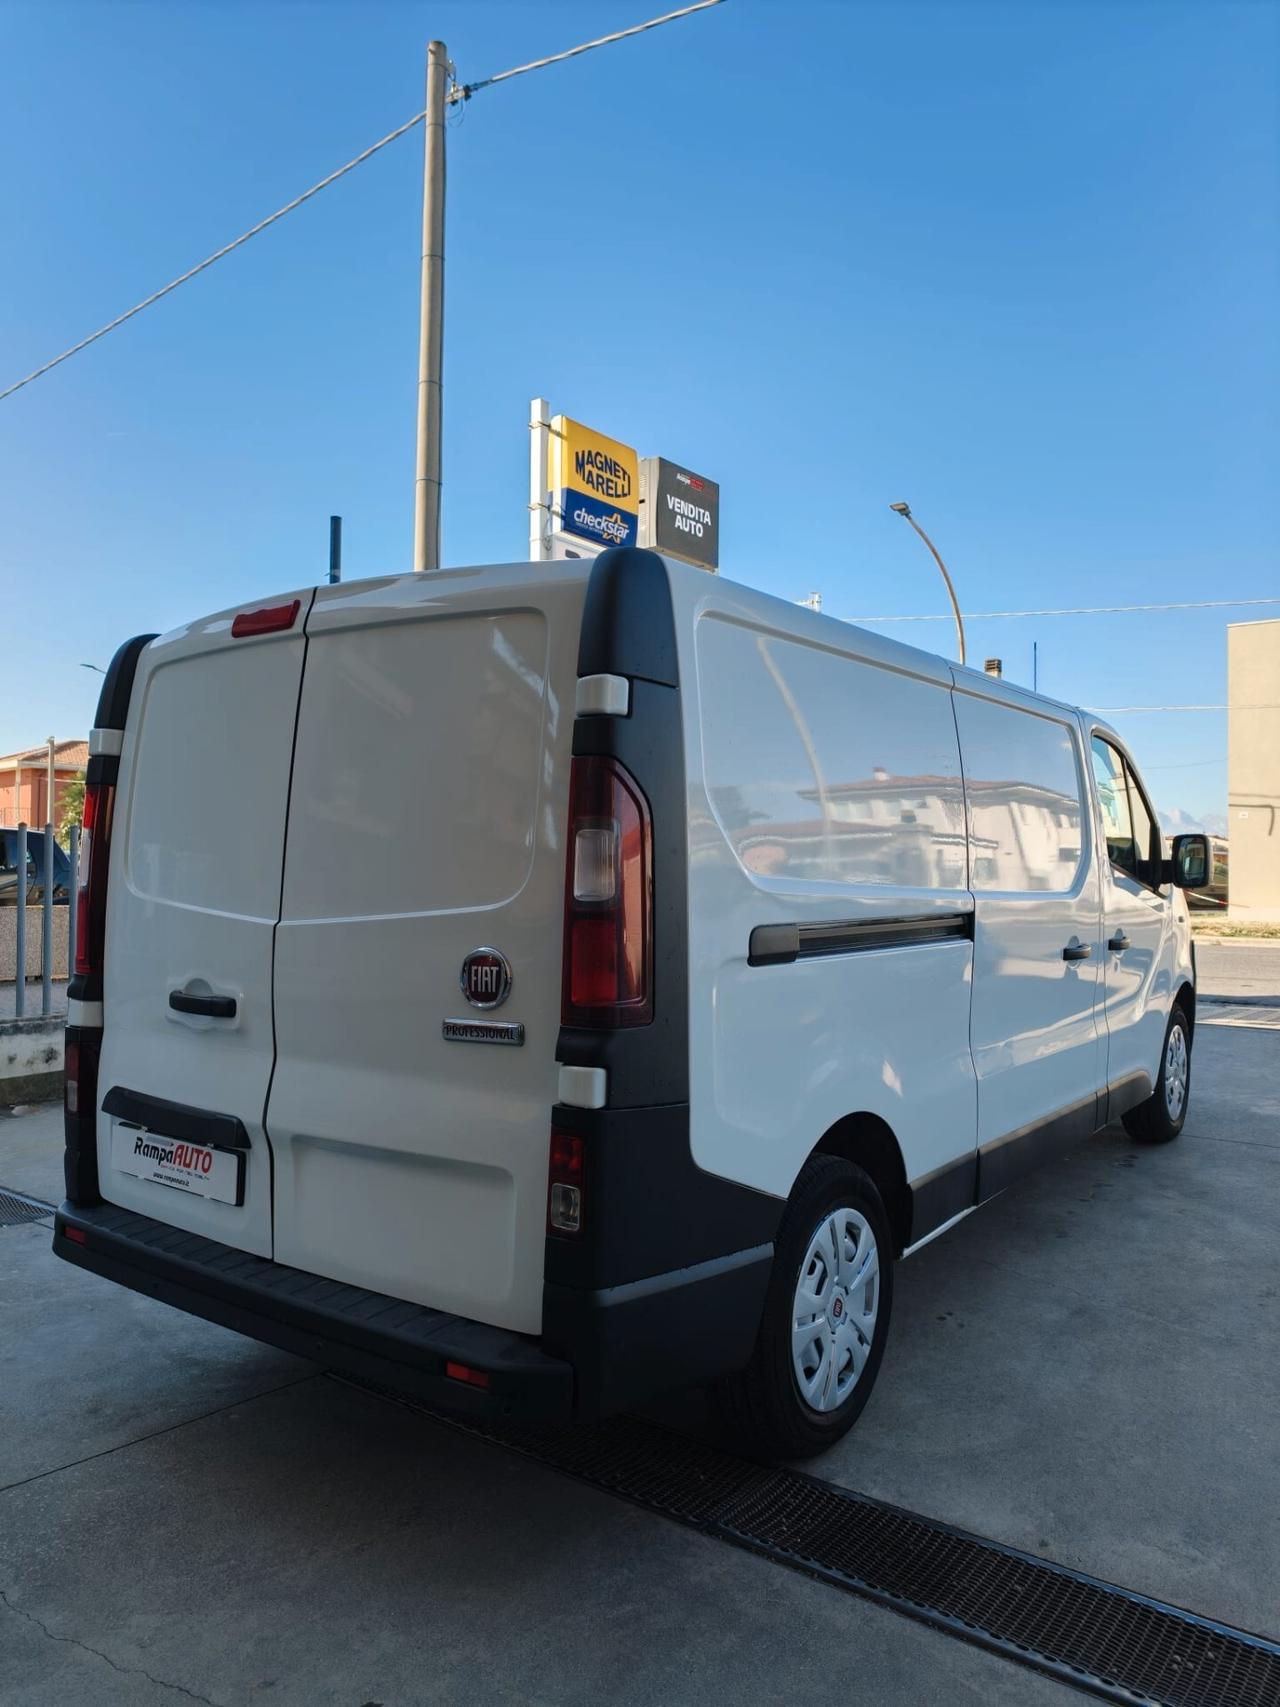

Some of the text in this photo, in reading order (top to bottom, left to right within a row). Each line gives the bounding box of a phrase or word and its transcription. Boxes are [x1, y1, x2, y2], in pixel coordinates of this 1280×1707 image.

[575, 449, 631, 483] MAGNETI
[575, 465, 631, 498] MARELLI
[574, 508, 630, 538] checkstar
[667, 494, 711, 526] VENDITA
[675, 515, 704, 538] AUTO
[471, 965, 499, 993] FIAT
[445, 1024, 516, 1040] PROFESSIONAL
